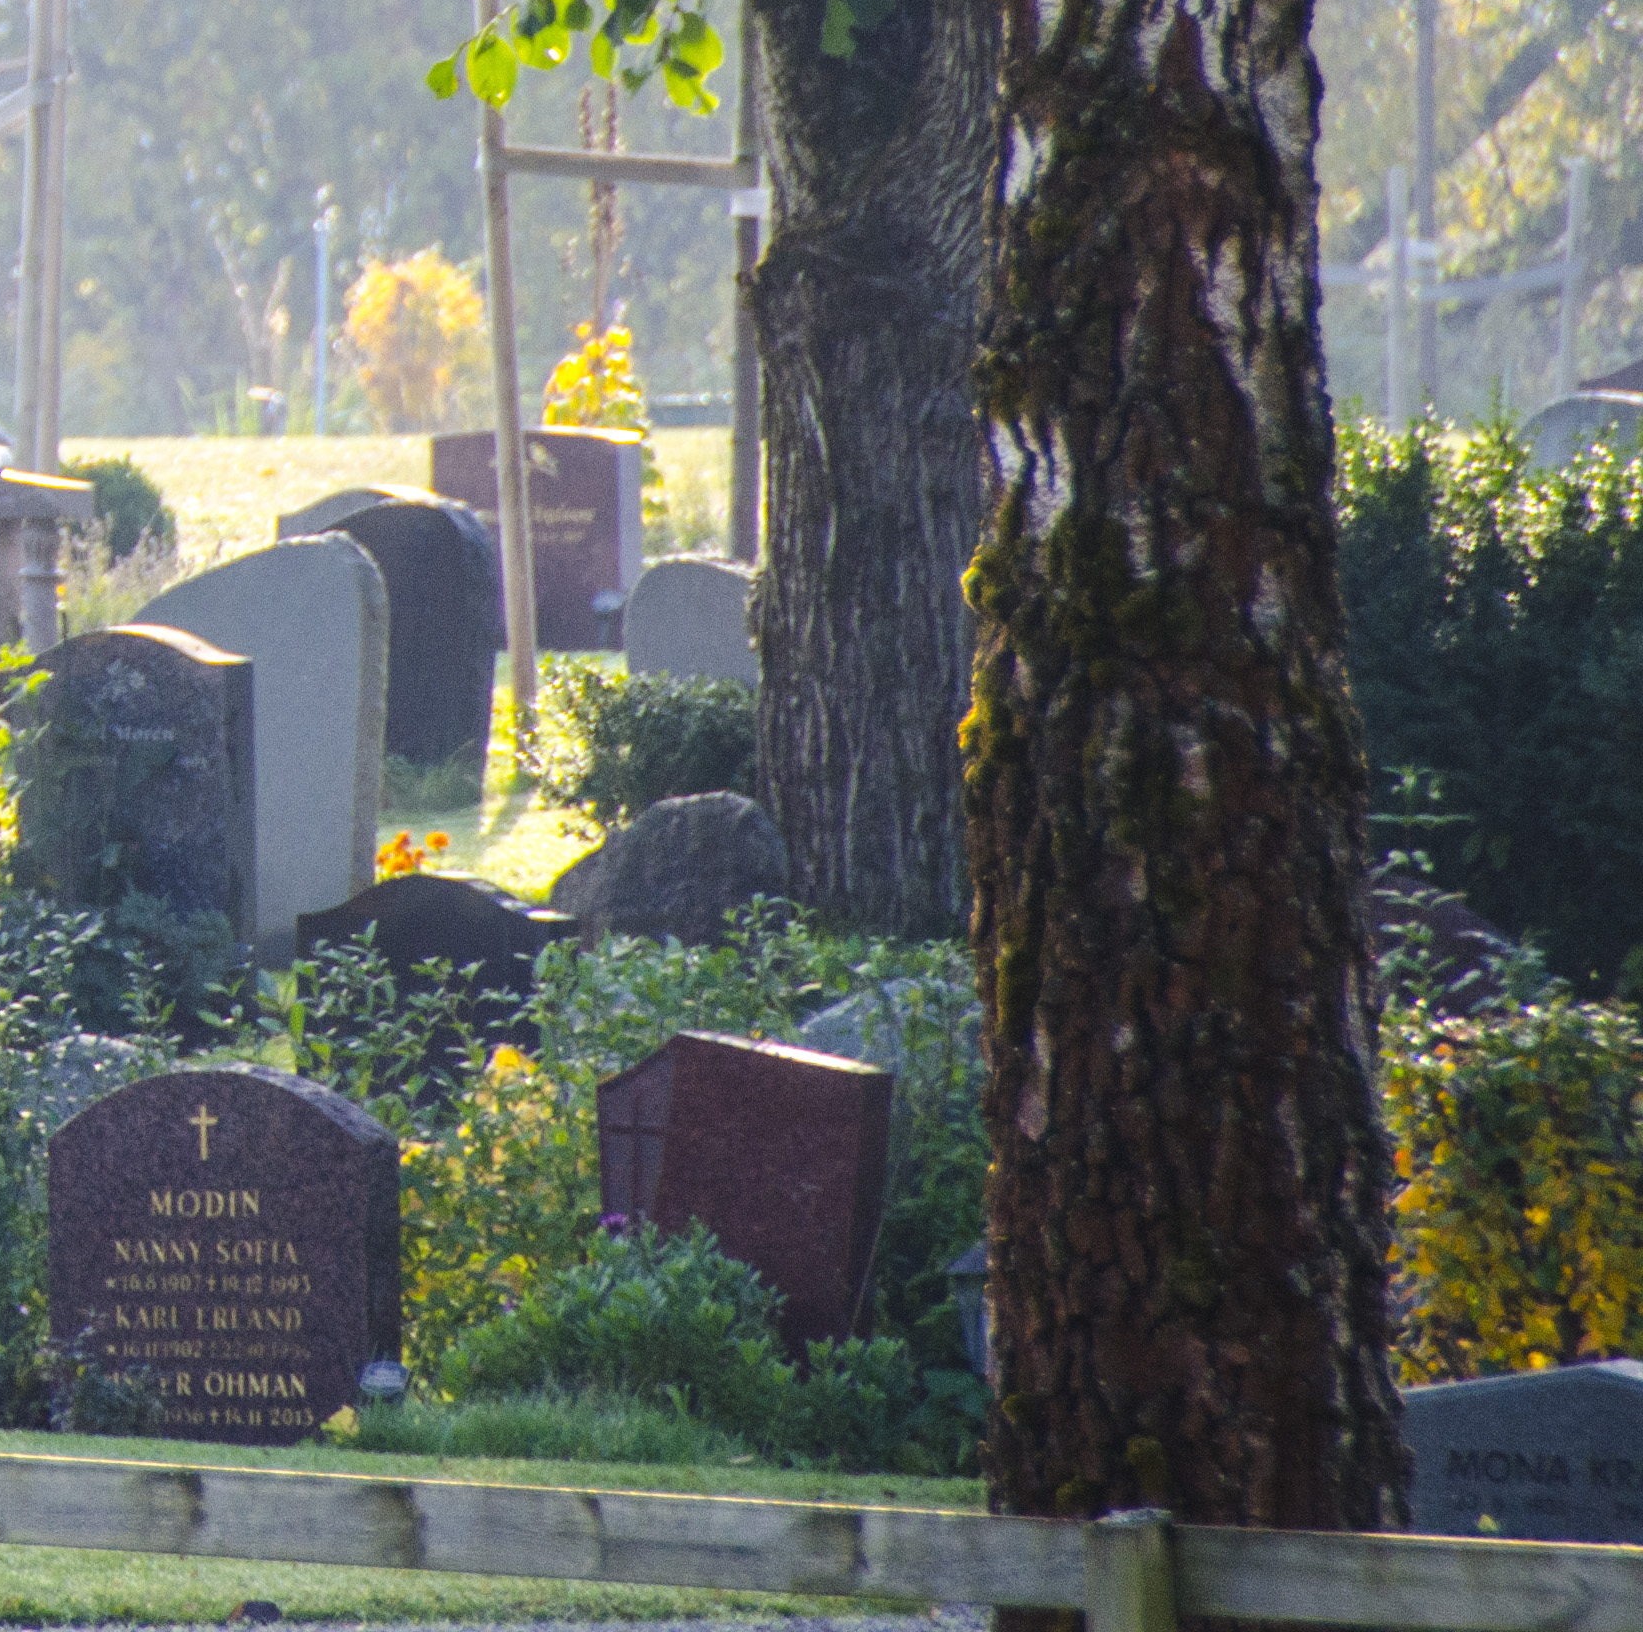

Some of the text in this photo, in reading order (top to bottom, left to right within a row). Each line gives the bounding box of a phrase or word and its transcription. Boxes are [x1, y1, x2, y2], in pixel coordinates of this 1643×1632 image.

[150, 1189, 261, 1218] MODIN
[114, 1238, 301, 1265] NANNY SOFIA
[115, 1305, 303, 1331] KARL ERLAND
[1447, 1450, 1571, 1486] MONA
